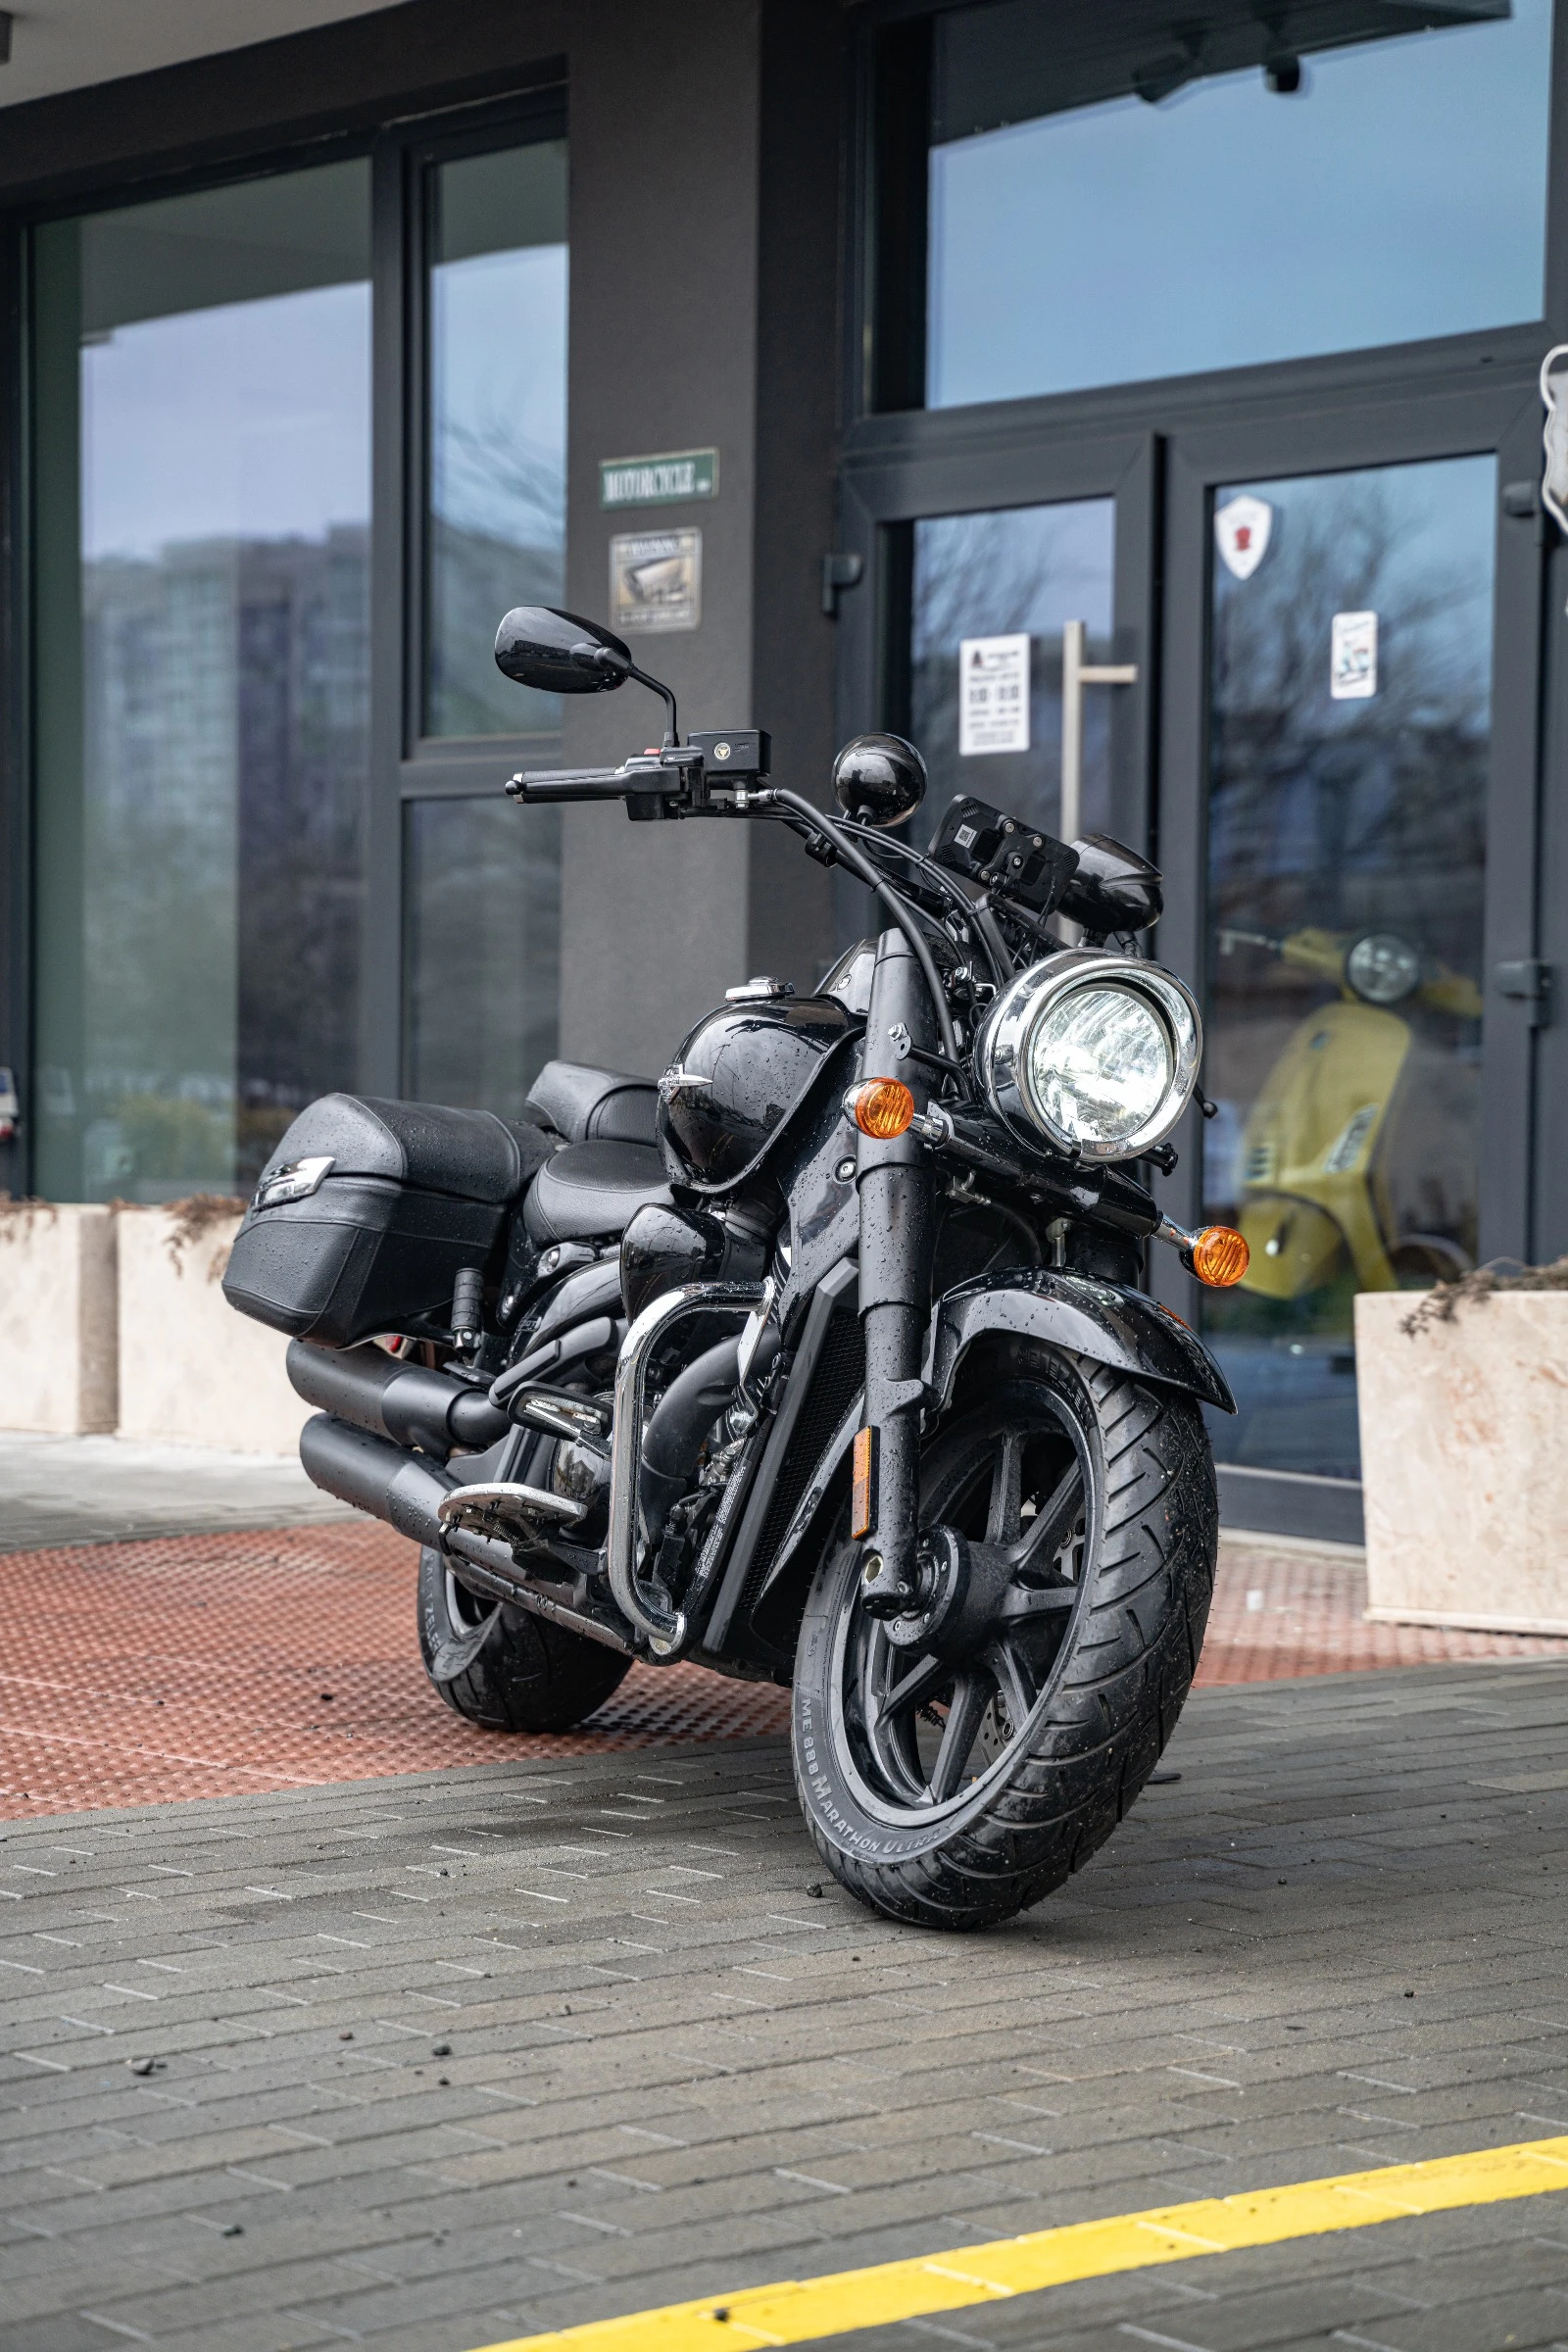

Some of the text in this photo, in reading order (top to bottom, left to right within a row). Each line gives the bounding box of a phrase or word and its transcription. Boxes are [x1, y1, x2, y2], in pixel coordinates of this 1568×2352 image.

[802, 1698, 940, 1853] ME 888 MARATHON ULTRA
